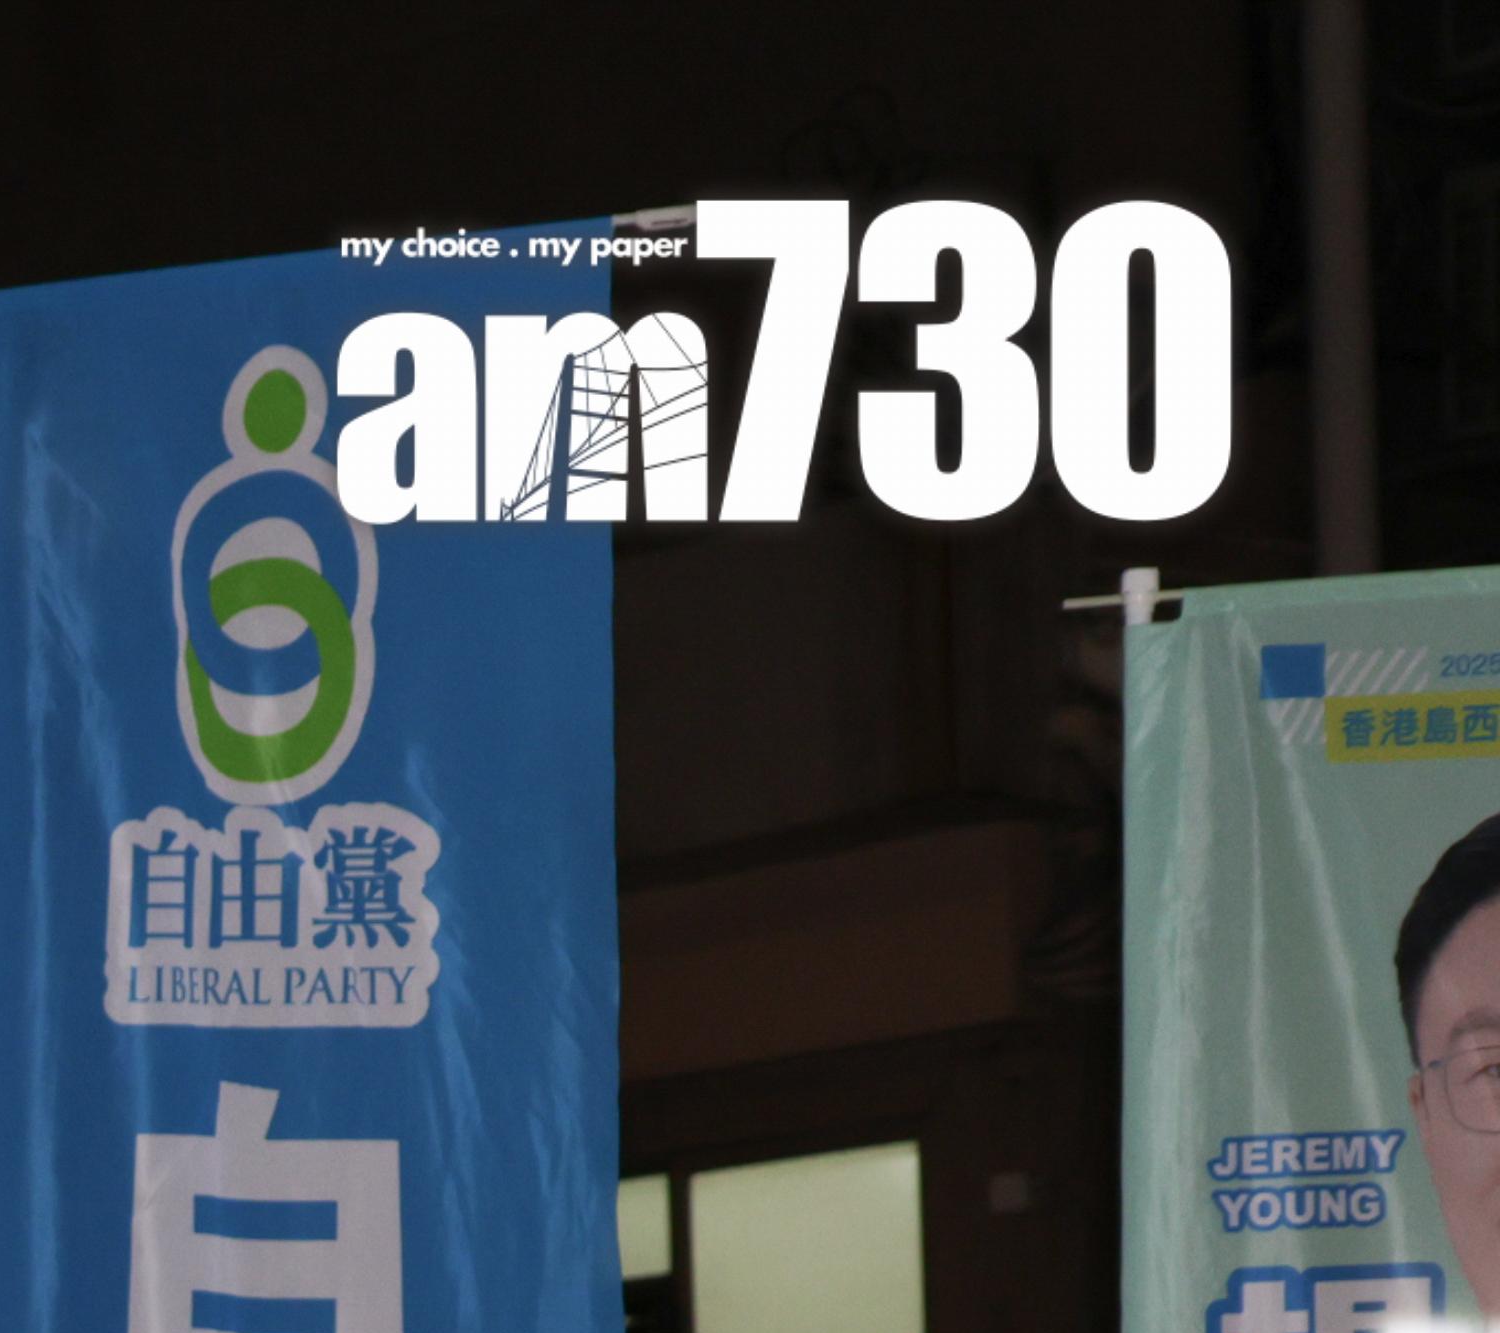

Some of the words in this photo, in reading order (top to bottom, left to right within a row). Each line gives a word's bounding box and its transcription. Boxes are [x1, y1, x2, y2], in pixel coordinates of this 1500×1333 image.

[126, 825, 416, 950] 自由黨
[128, 966, 271, 1005] LIBERAL
[283, 966, 415, 1006] PARTY
[1212, 1134, 1400, 1177] JEREMY
[1219, 1187, 1384, 1228] YOUNG
